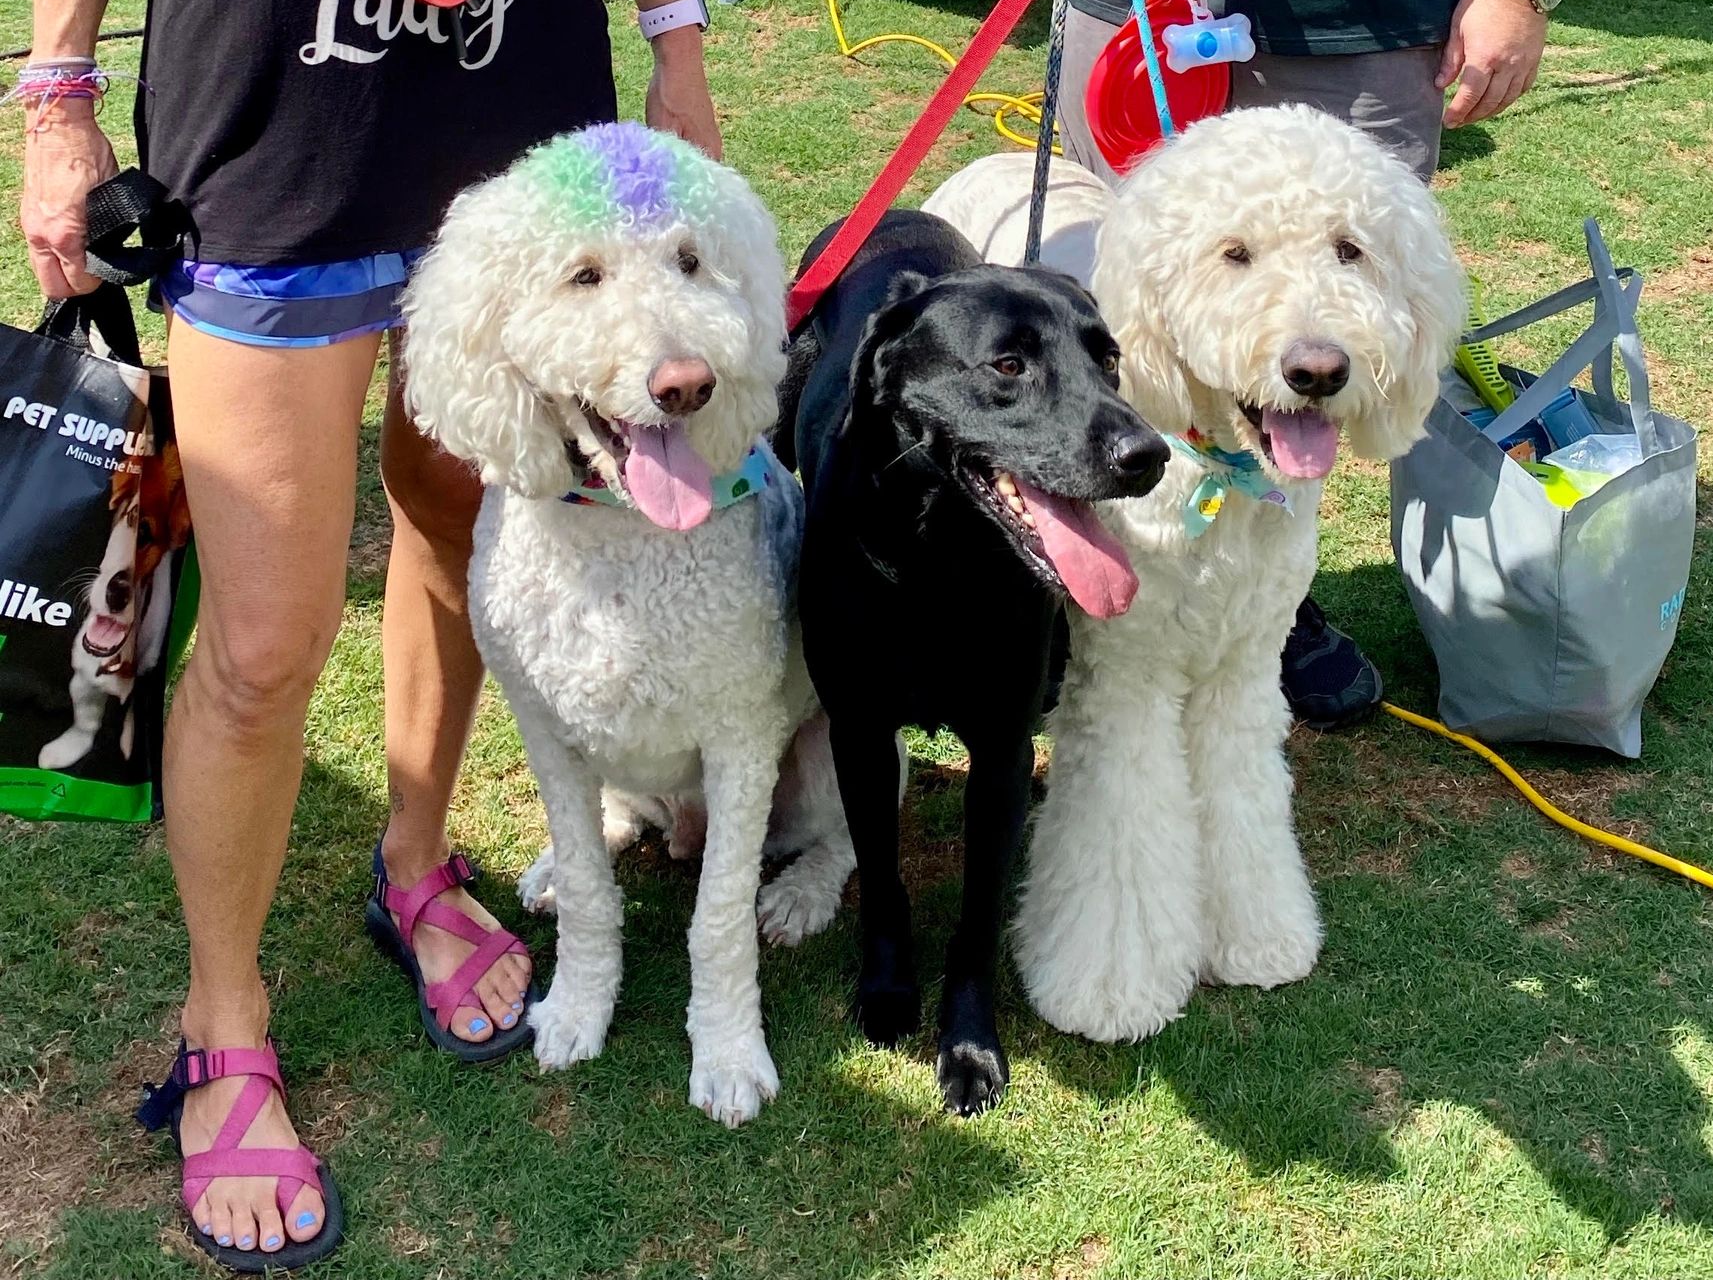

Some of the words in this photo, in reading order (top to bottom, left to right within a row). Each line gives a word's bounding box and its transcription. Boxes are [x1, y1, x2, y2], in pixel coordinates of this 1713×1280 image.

[3, 396, 58, 430] PET
[66, 444, 103, 467] Minus
[104, 455, 126, 473] the
[0, 579, 72, 627] like
